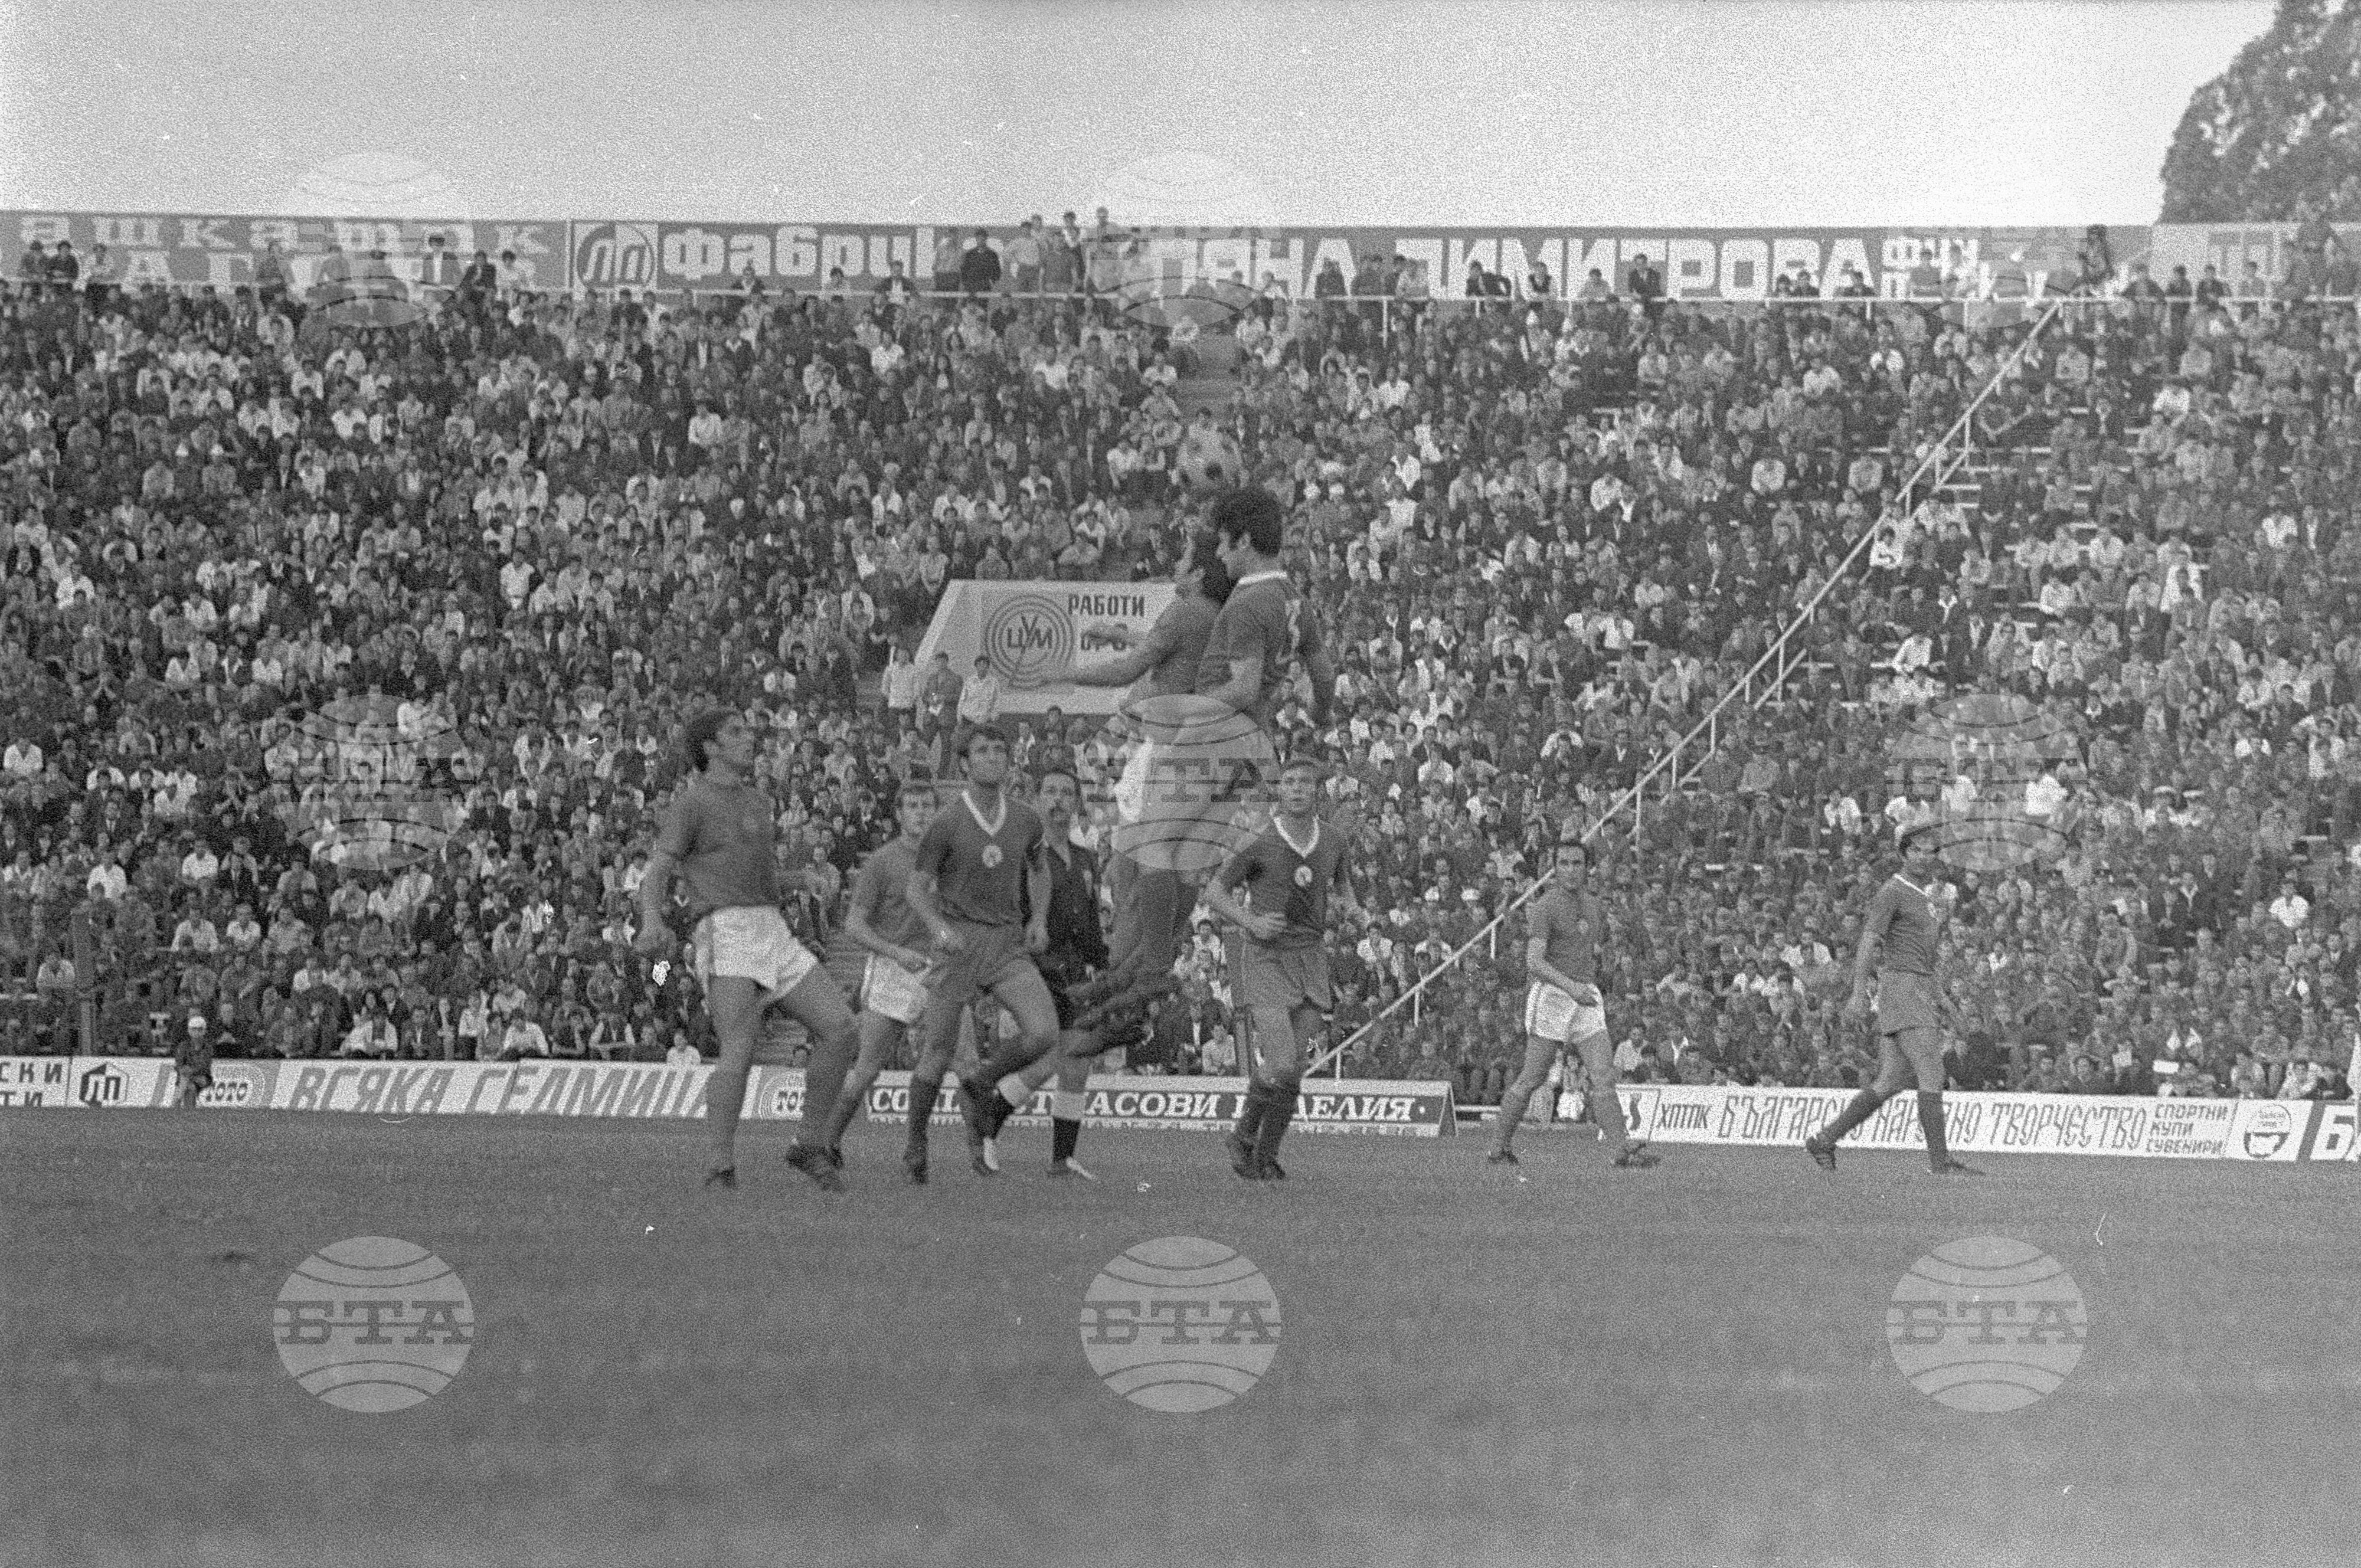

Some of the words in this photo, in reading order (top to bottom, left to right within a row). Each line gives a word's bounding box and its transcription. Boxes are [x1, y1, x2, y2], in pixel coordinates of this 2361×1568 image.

[1068, 594, 1144, 617] РАБОТИ
[1006, 616, 1052, 666] ЦУМ
[2150, 1121, 2194, 1137] КУПИ
